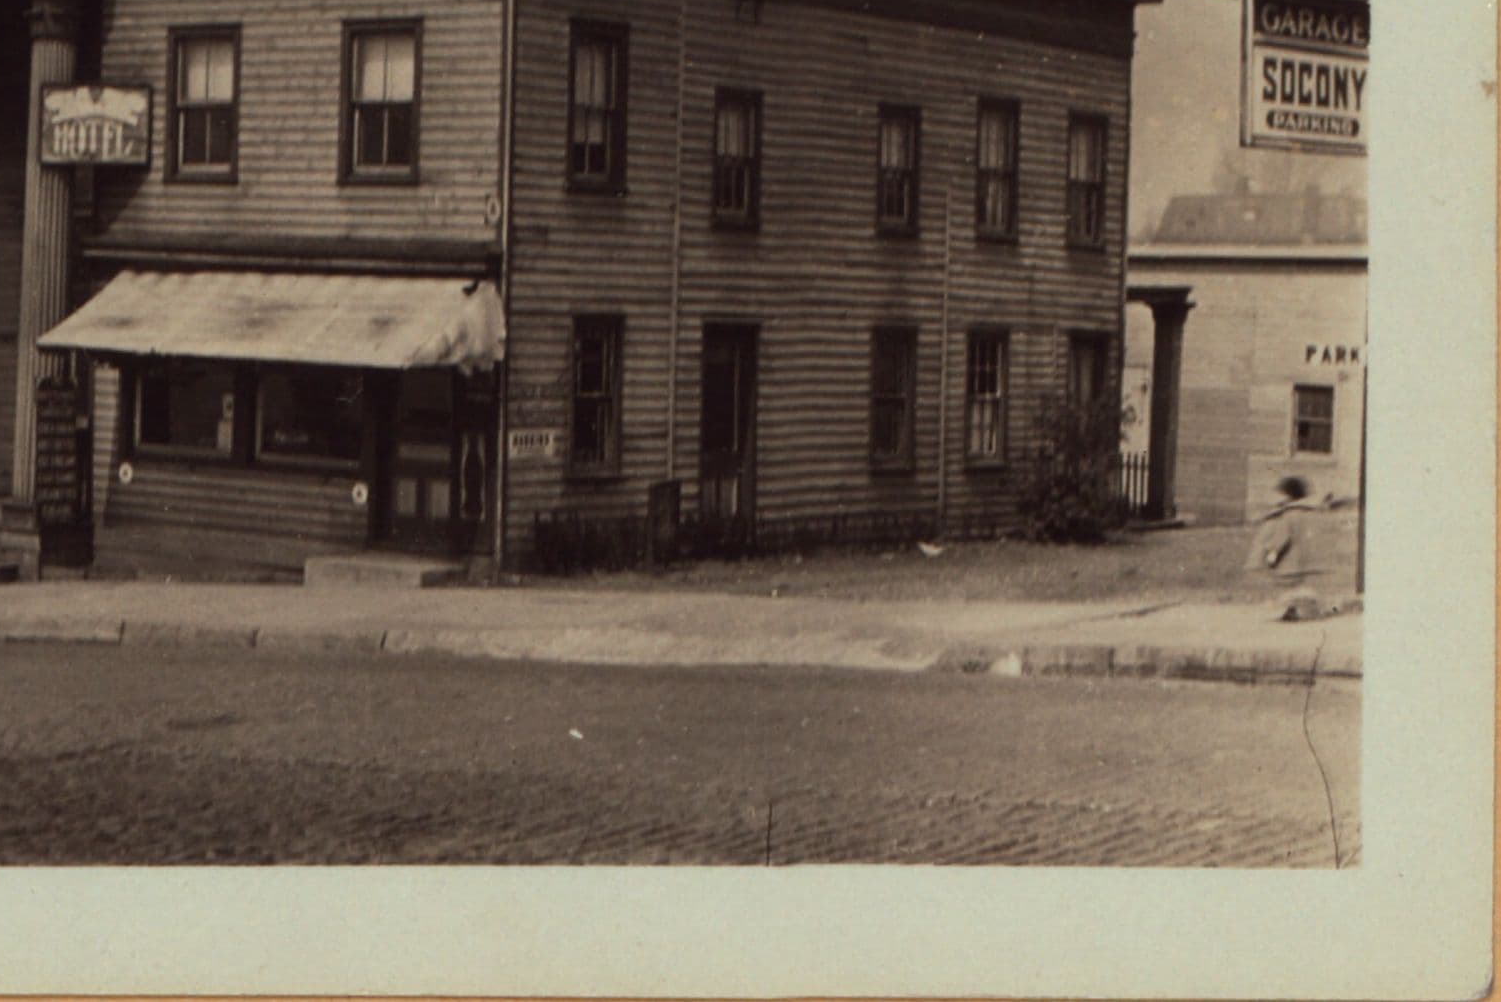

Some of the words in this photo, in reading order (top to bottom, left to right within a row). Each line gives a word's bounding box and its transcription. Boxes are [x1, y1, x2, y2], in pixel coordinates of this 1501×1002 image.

[1261, 2, 1367, 45] GARAGE
[1262, 57, 1367, 112] SOCONY
[53, 119, 134, 162] HOTEL
[1274, 110, 1353, 136] PARKING
[1305, 343, 1360, 366] PARK
